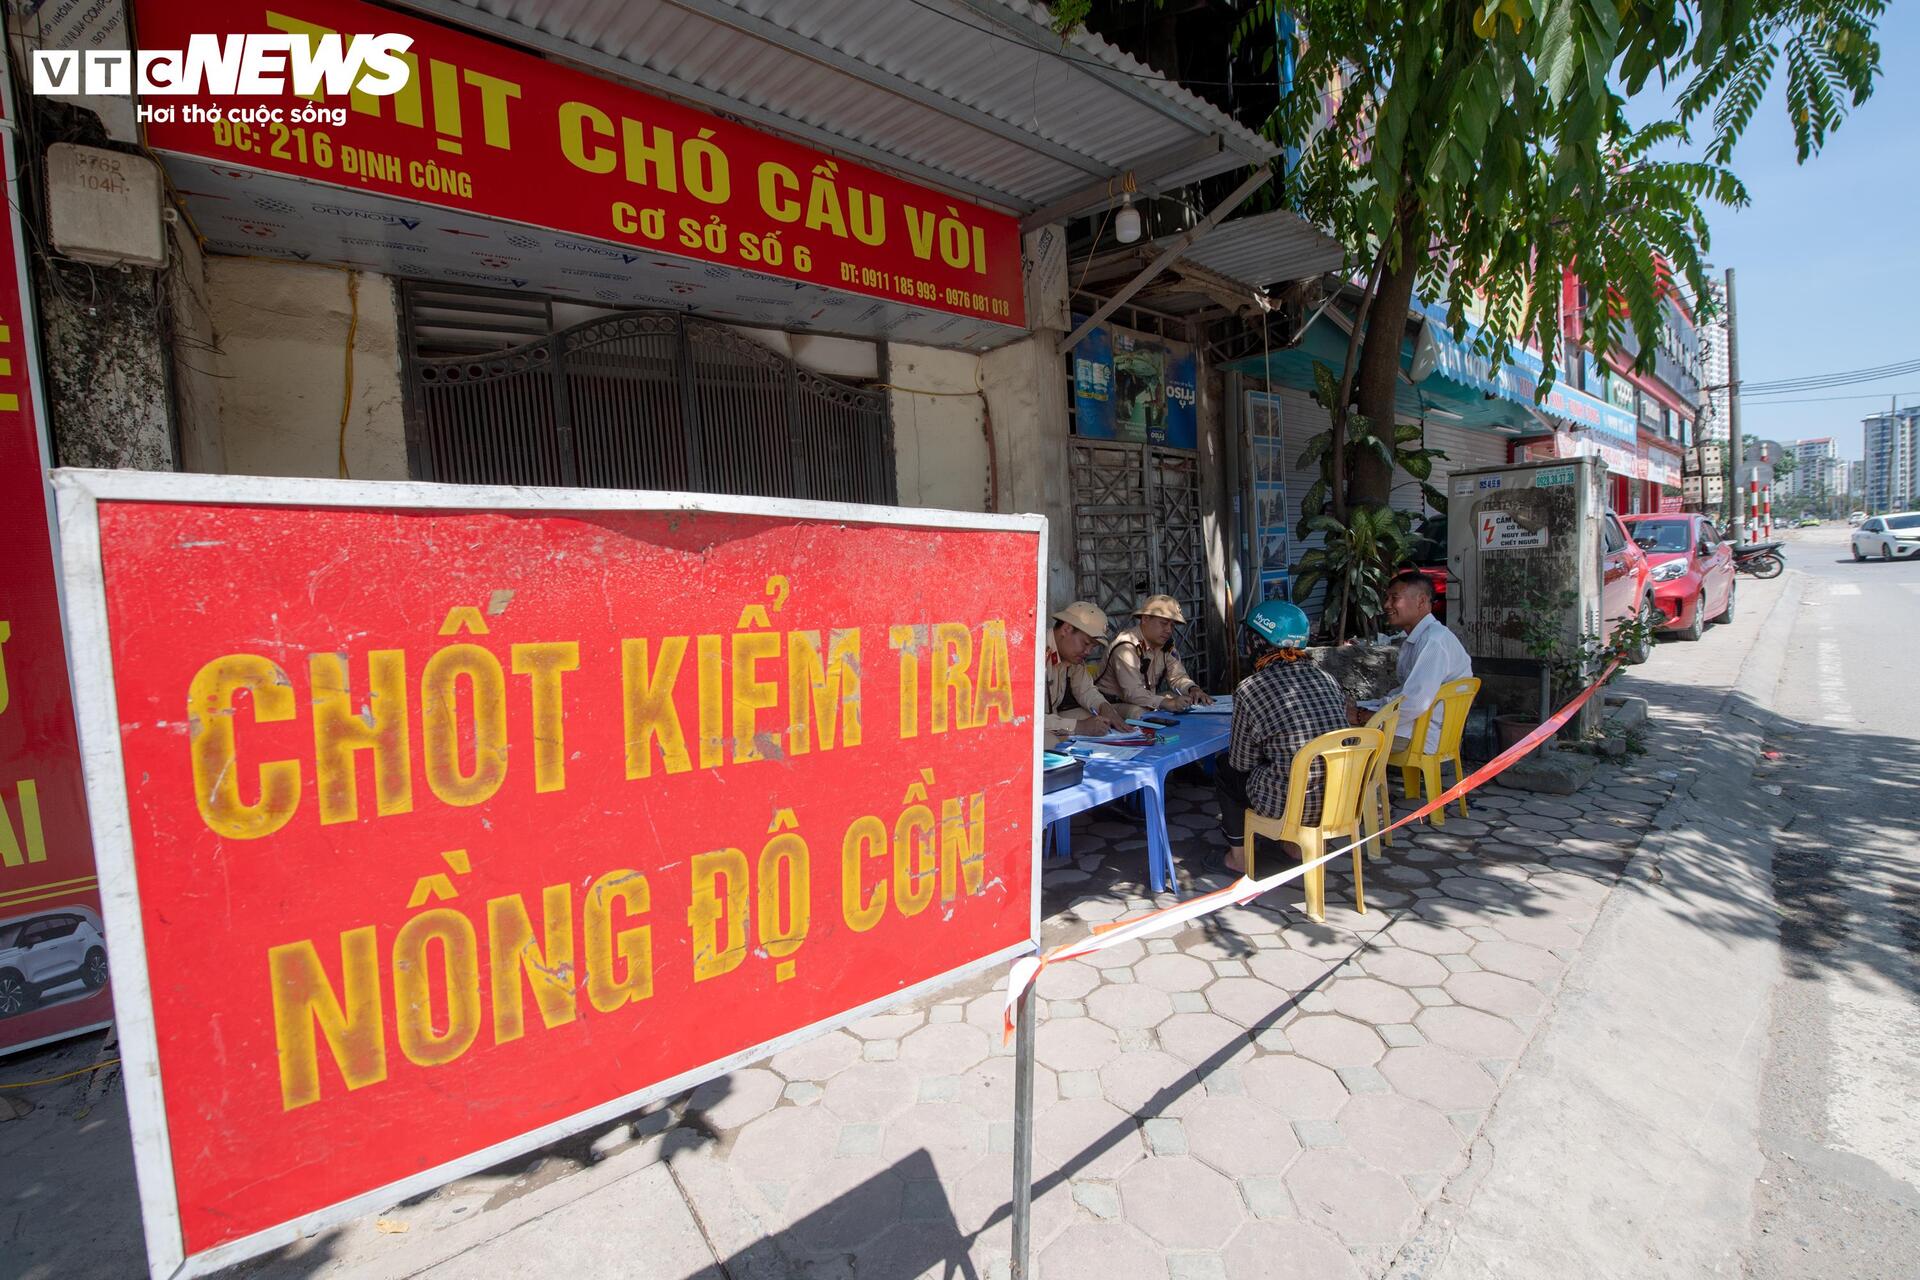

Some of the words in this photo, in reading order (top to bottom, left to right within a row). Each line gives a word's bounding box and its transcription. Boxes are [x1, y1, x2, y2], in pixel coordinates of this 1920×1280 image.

[213, 118, 261, 153] ĐC:
[269, 122, 333, 168] 216
[341, 144, 402, 184] ĐỊNH
[409, 160, 472, 198] CÔNG
[558, 100, 731, 204] CHÓ
[757, 160, 887, 247] CẦU
[903, 205, 987, 275] VÒI
[611, 201, 666, 240] CƠ
[679, 215, 728, 254] SỞ
[740, 225, 783, 267] SỐ
[794, 245, 812, 273] 6
[841, 262, 859, 284] ĐT:
[862, 269, 889, 291] 0911
[894, 276, 914, 296] 185
[917, 280, 937, 300] 993
[946, 287, 970, 308] 0976
[973, 293, 989, 313] 081
[992, 298, 1009, 317] 018
[189, 589, 580, 839] CHỐT
[621, 574, 861, 781] KIỂM
[888, 618, 1014, 739] TRA
[268, 849, 654, 1111] NỒNG
[687, 807, 811, 984] ĐỘ
[842, 767, 985, 932] CỒN
